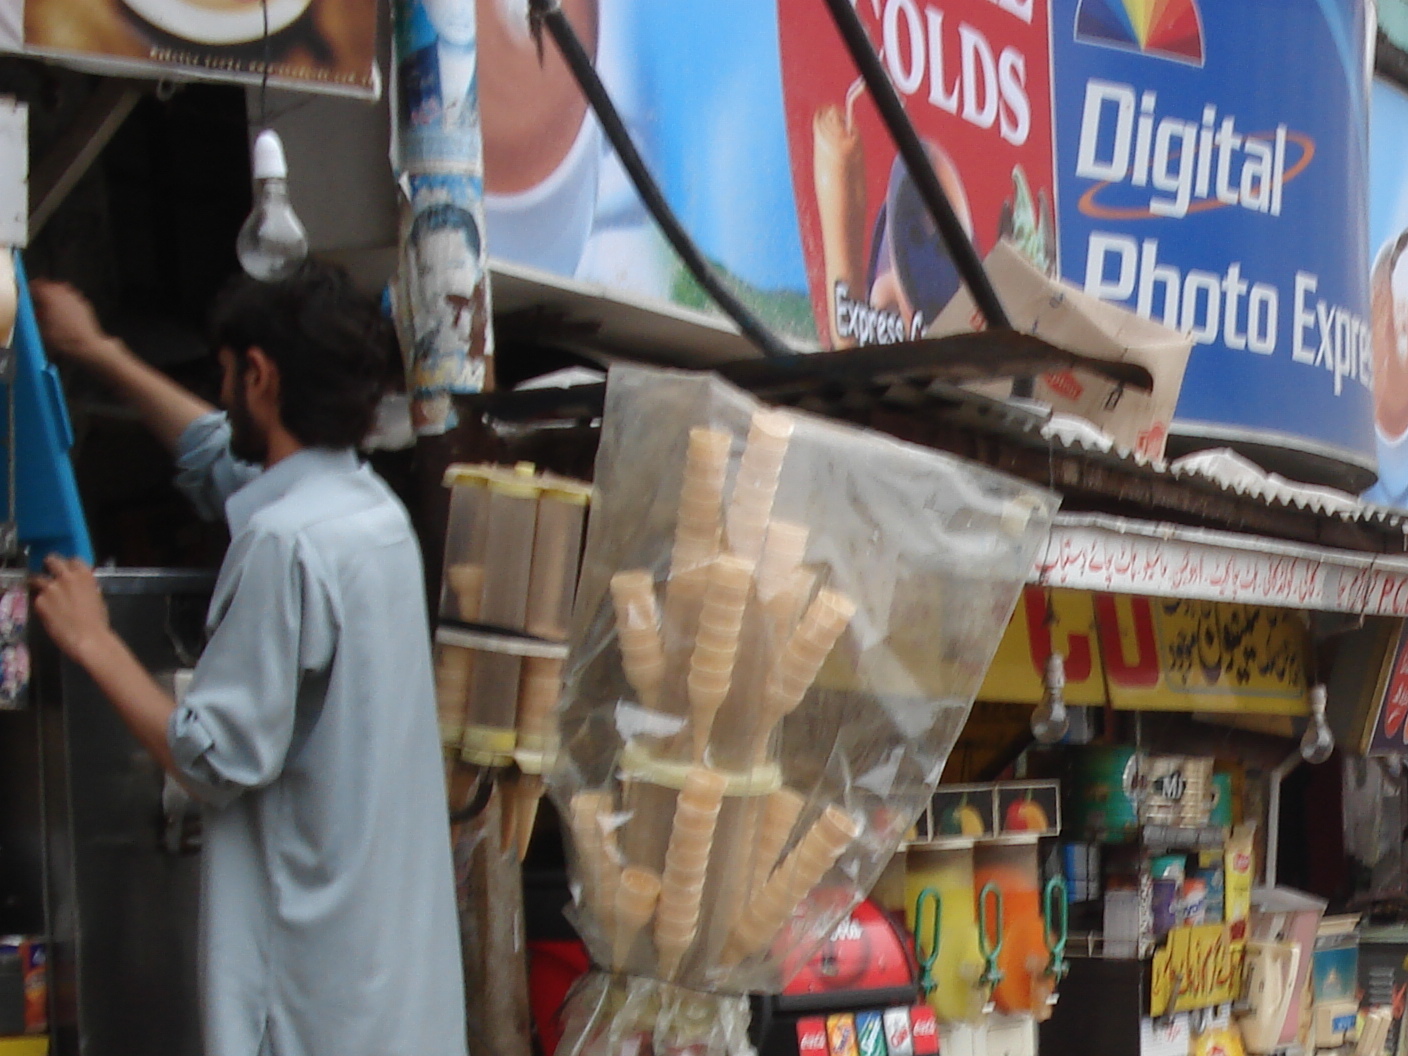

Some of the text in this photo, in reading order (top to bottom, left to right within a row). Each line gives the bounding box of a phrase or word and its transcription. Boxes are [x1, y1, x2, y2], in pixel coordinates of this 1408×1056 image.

[866, 0, 1031, 146] OLDS
[1075, 76, 1287, 219] Digital
[834, 280, 904, 346] Express
[1084, 230, 1279, 355] Photo
